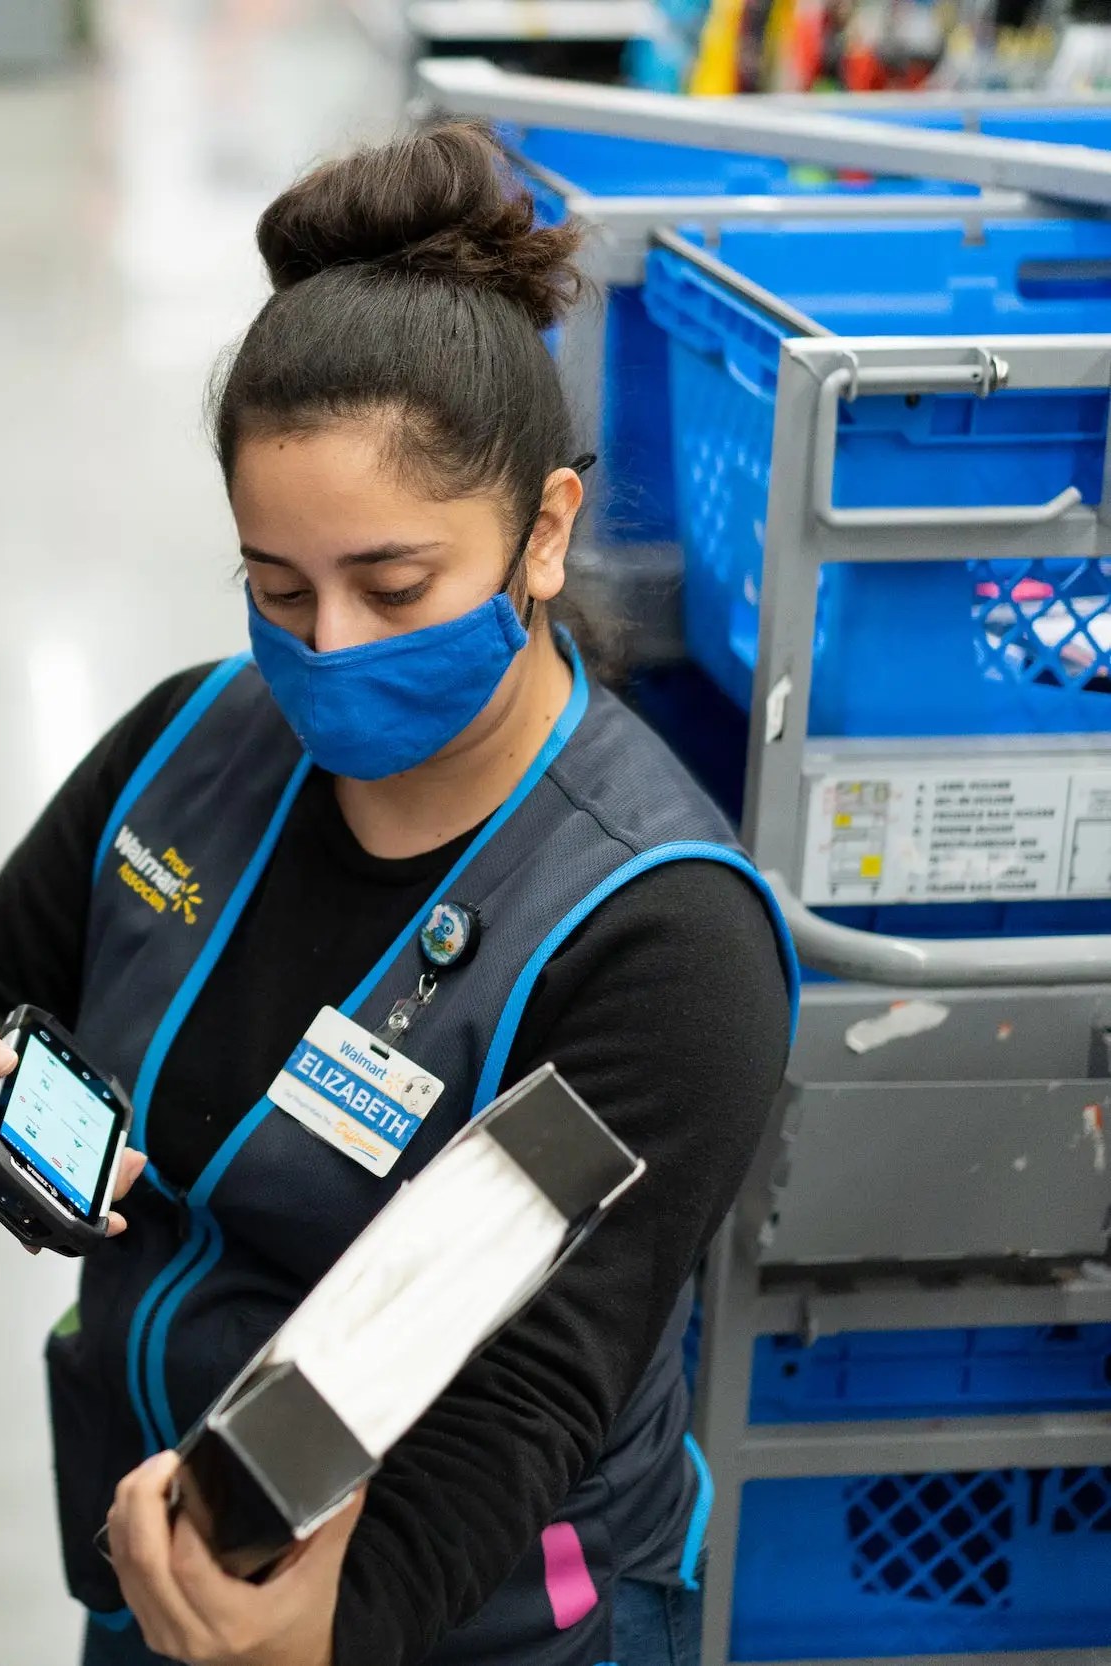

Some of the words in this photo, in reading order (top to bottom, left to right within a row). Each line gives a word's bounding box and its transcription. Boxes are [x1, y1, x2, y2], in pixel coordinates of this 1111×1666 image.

[114, 824, 184, 898] Walmart
[162, 847, 194, 878] Proud
[339, 1039, 389, 1081] Walmart
[296, 1051, 410, 1139] ELIZABETH
